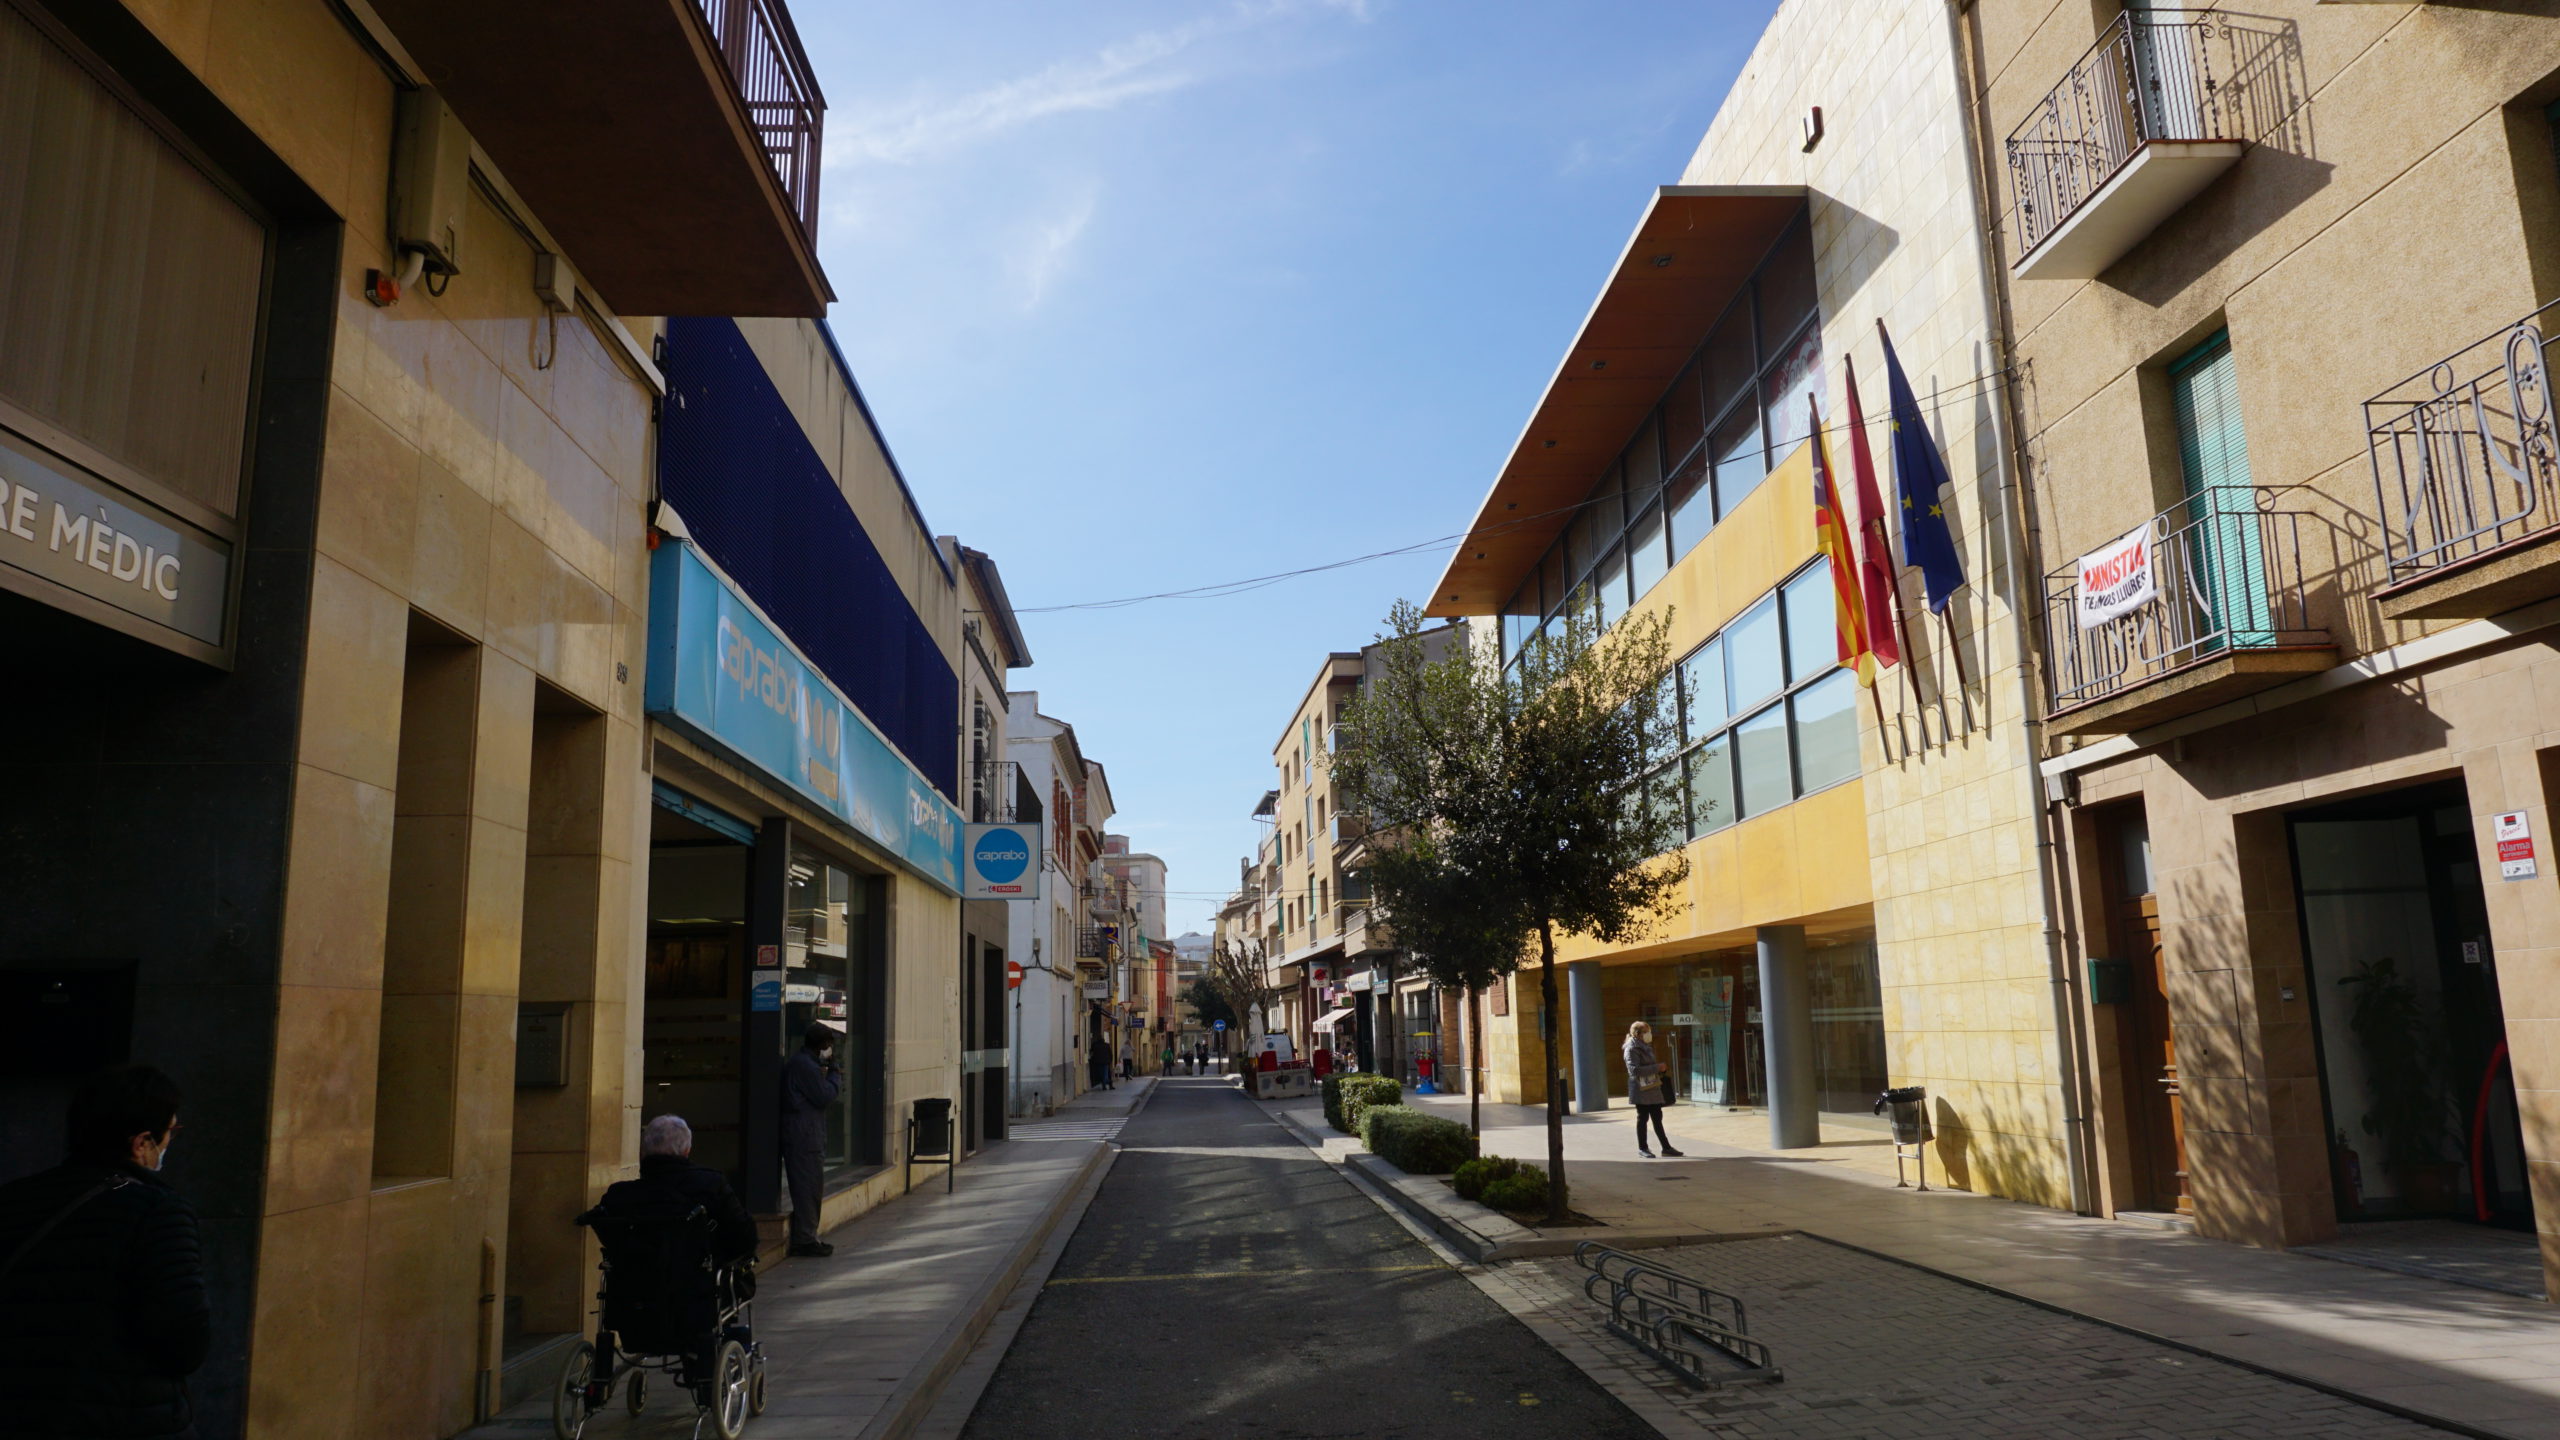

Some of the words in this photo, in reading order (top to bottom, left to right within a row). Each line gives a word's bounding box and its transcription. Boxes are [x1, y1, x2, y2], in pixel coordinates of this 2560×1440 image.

[49, 502, 182, 602] MÈDIC
[2116, 571, 2147, 604] LLIURES
[718, 615, 799, 724] caprabo
[976, 849, 1026, 862] caprabo
[2499, 842, 2531, 852] Alarma
